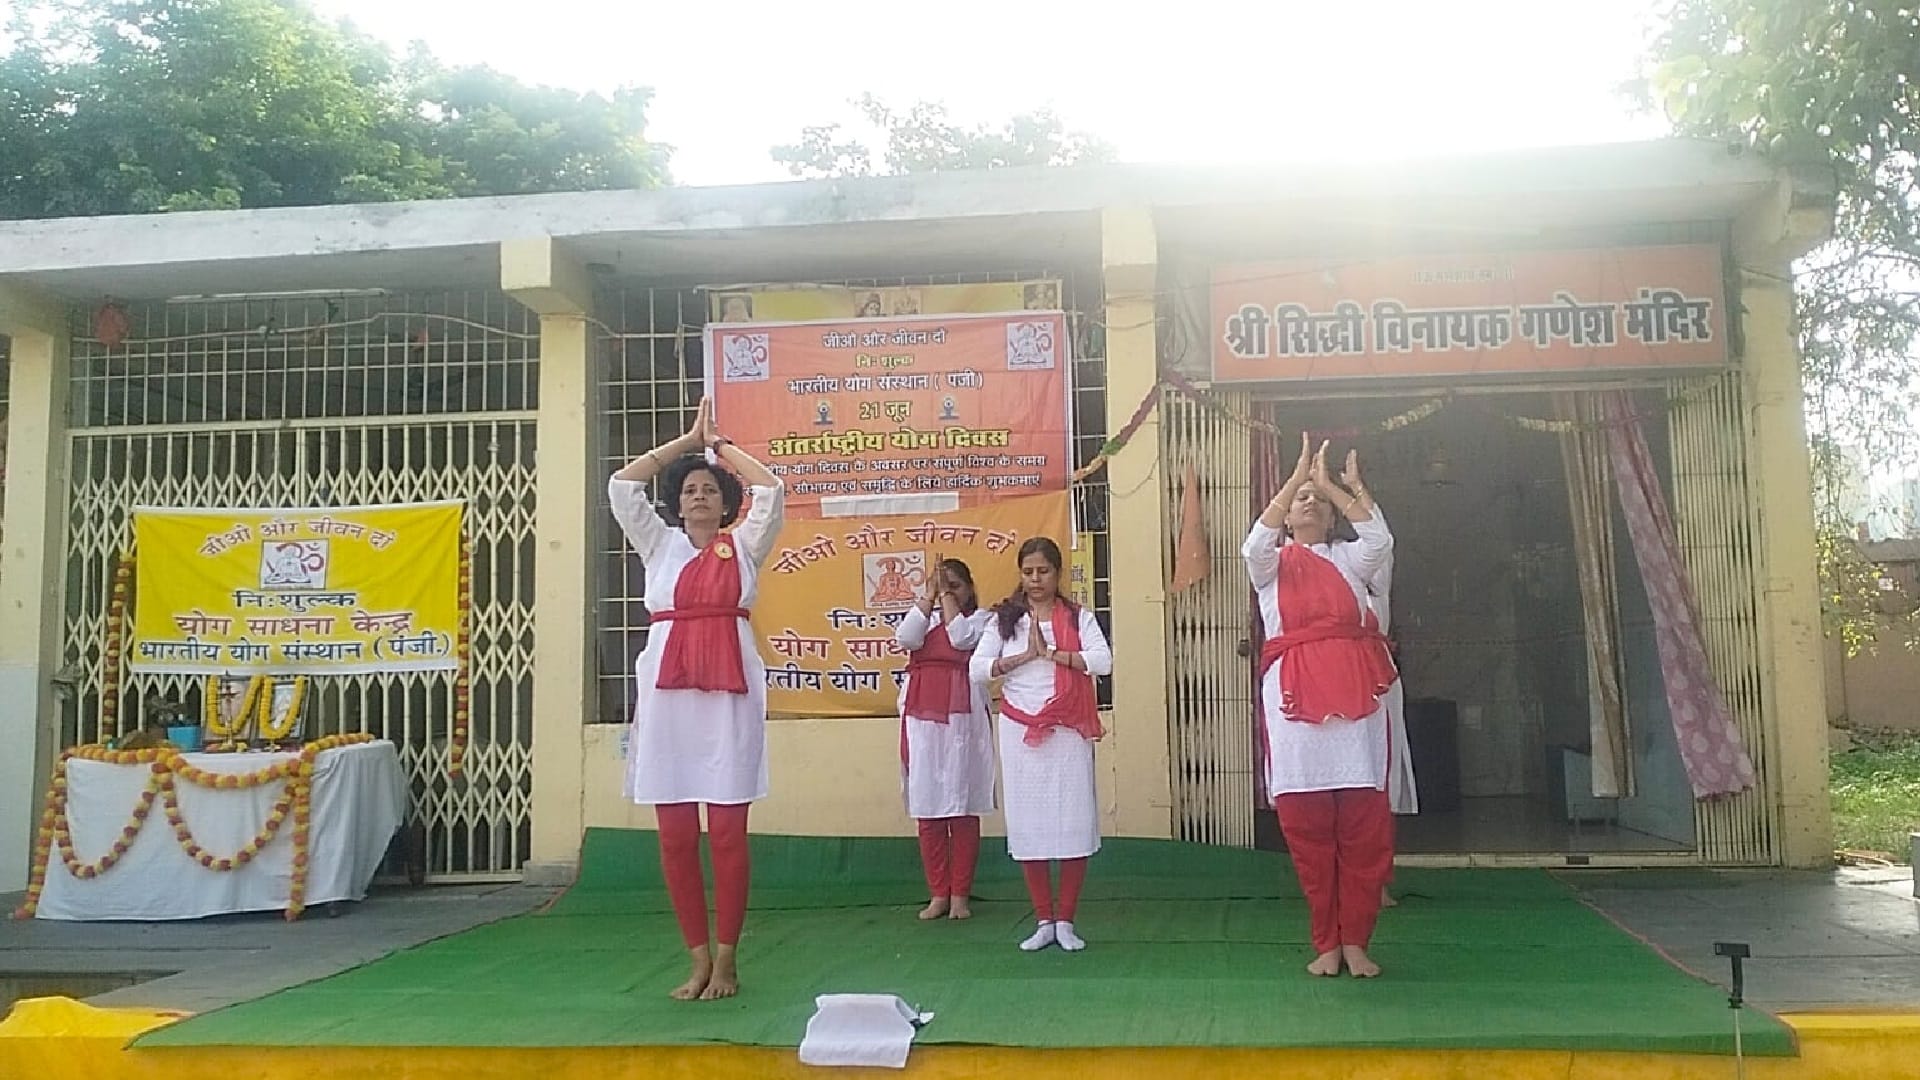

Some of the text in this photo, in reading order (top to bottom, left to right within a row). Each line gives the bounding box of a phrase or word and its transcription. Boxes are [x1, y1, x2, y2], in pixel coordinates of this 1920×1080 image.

[1225, 304, 1269, 357] श्री
[1371, 299, 1511, 352] विनायक
[1519, 292, 1618, 347] गणेश
[1622, 287, 1713, 344] मंदिर
[891, 328, 927, 345] जीवन
[788, 374, 839, 395] भारतीय
[845, 373, 871, 391] योग
[877, 372, 928, 390] संस्थान
[859, 400, 912, 422] 21 जून
[889, 427, 939, 451] योग
[944, 426, 1011, 449] दिवस
[791, 461, 814, 474] योग
[817, 460, 849, 474] दिवस
[853, 459, 866, 471] के
[871, 458, 908, 471] अवसर
[912, 459, 927, 470] पर
[998, 454, 1011, 467] के
[899, 478, 912, 490] के
[308, 516, 365, 538] जीवन
[771, 520, 1017, 574] जीओ और जीवन दो
[175, 610, 413, 635] योग साधना केन्द्र
[140, 636, 222, 661] भारतीय
[230, 636, 269, 661] योग
[281, 639, 362, 661] संस्थान
[770, 629, 829, 659] योग
[766, 661, 822, 691] रतीय
[827, 663, 880, 692] योग
